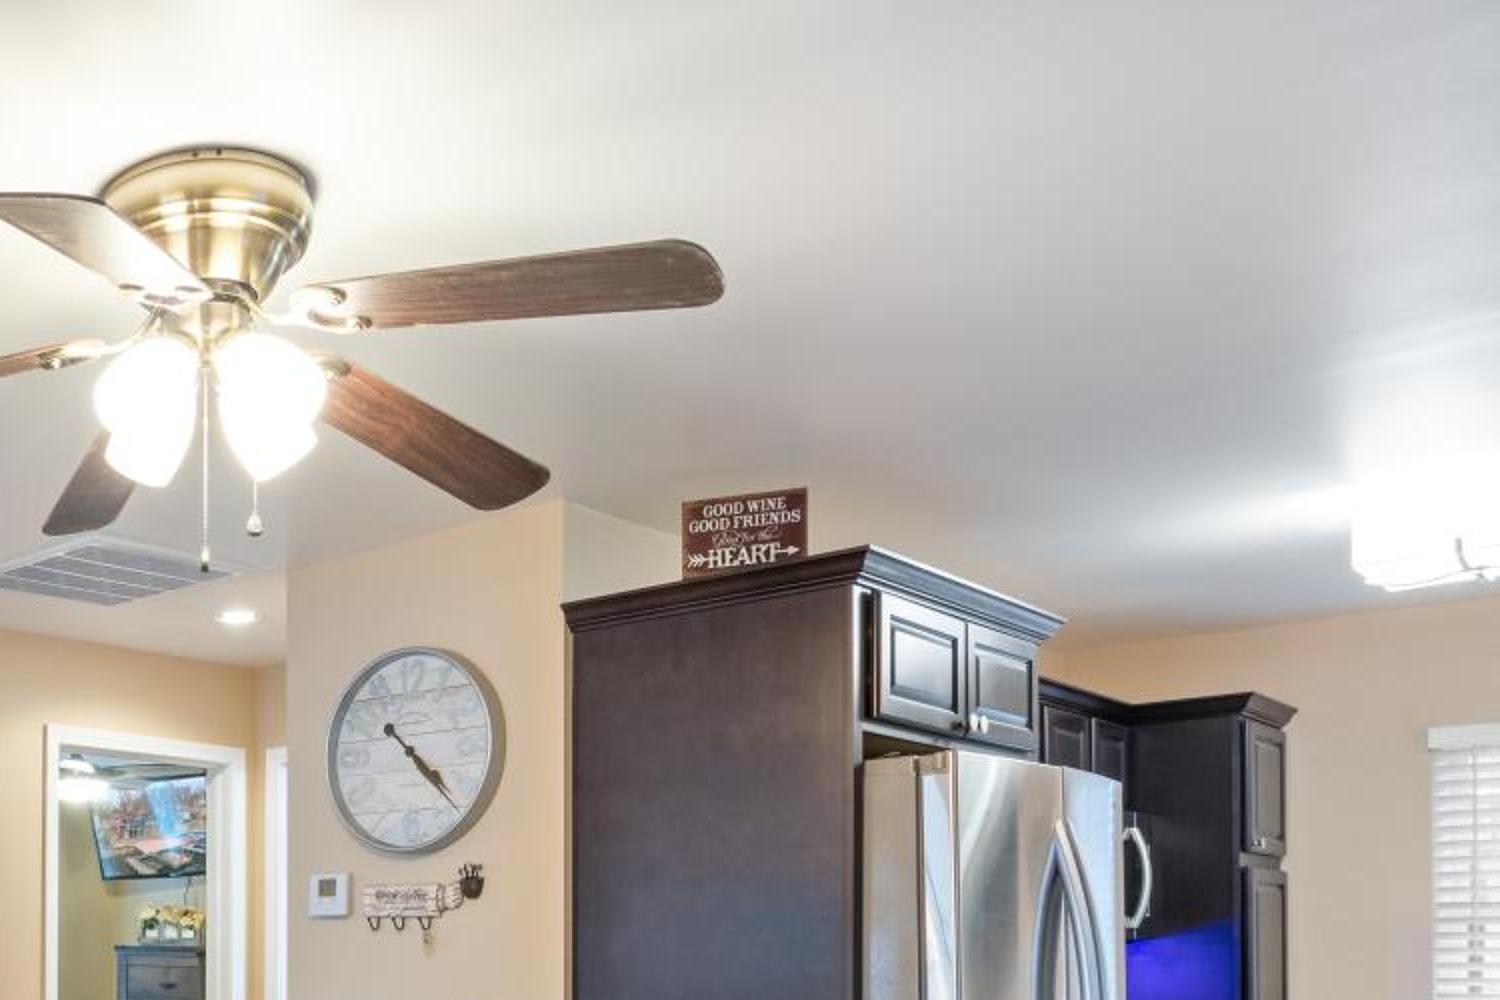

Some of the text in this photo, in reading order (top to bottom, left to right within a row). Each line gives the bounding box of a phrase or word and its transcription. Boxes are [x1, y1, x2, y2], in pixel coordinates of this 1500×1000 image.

[703, 496, 787, 518] GOOD WINE
[689, 509, 801, 533] GOOD FRIENDS
[707, 541, 781, 569] HEART
